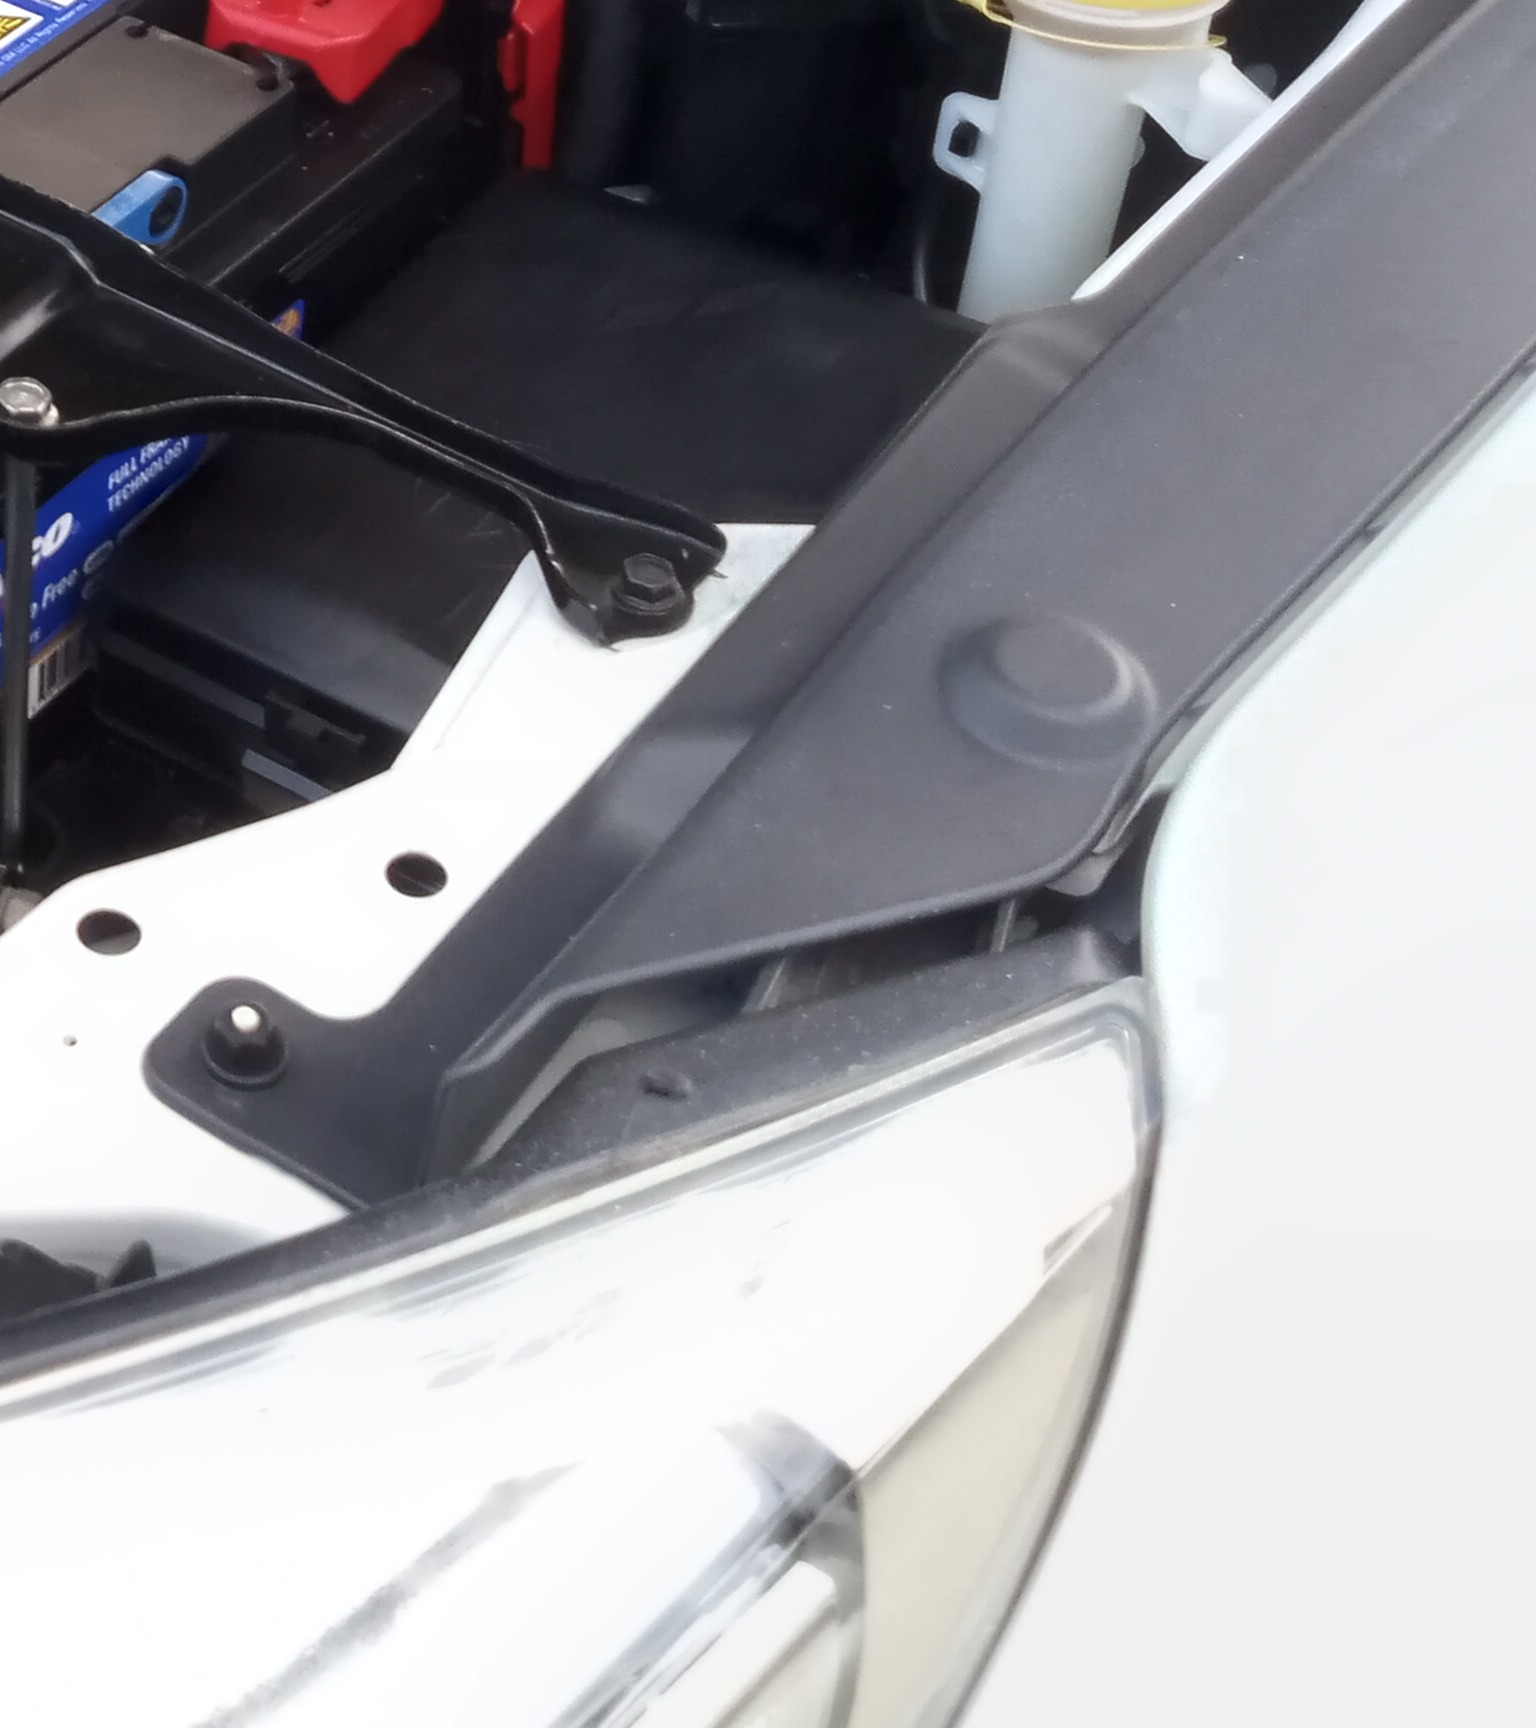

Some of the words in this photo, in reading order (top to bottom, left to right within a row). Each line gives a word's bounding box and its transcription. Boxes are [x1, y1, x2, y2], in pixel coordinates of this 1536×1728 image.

[107, 436, 190, 512] TECHNOLOGY
[108, 457, 137, 490] FULL
[42, 569, 79, 608] Free
